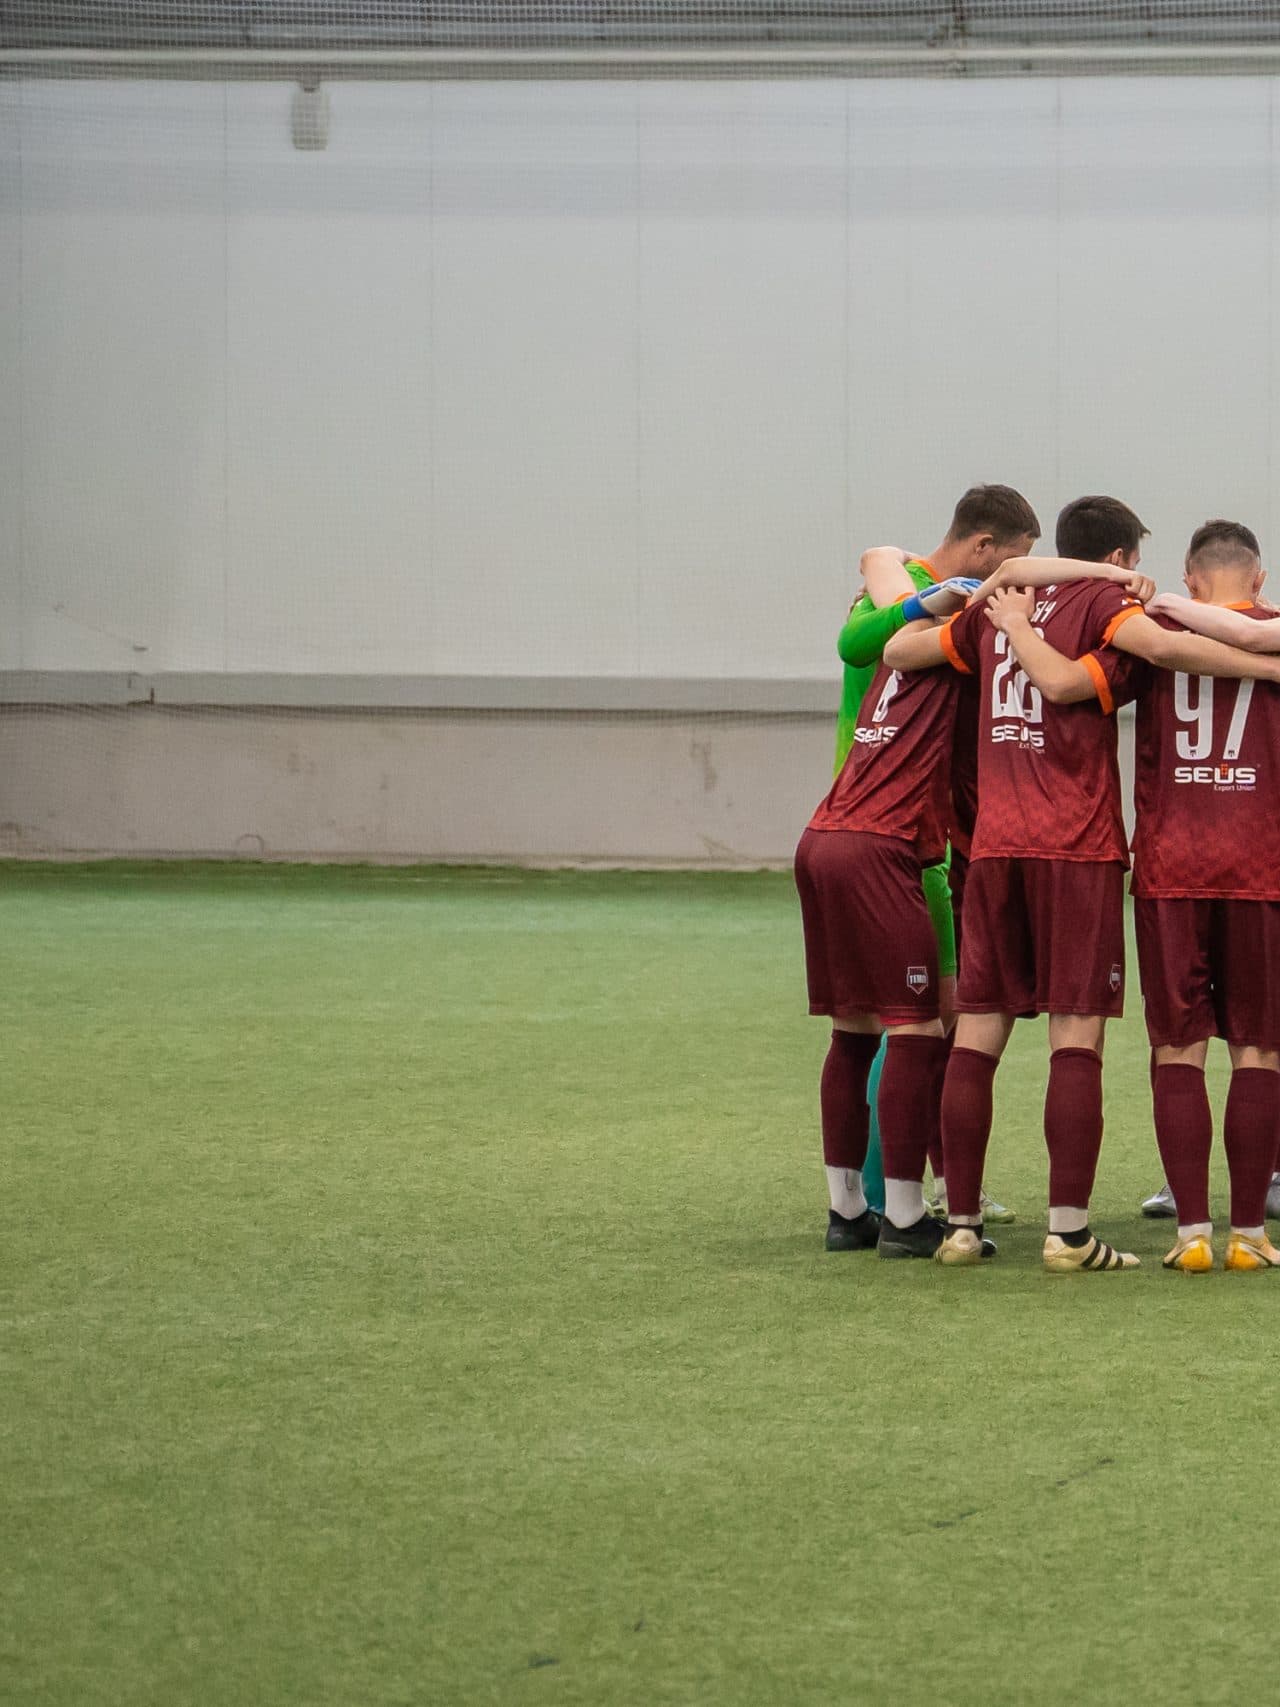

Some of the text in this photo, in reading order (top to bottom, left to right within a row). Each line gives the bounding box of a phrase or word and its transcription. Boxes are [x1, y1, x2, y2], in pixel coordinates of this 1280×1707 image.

[1174, 671, 1255, 760] 97
[992, 724, 1045, 747] SEUS
[1174, 766, 1256, 784] SEUS
